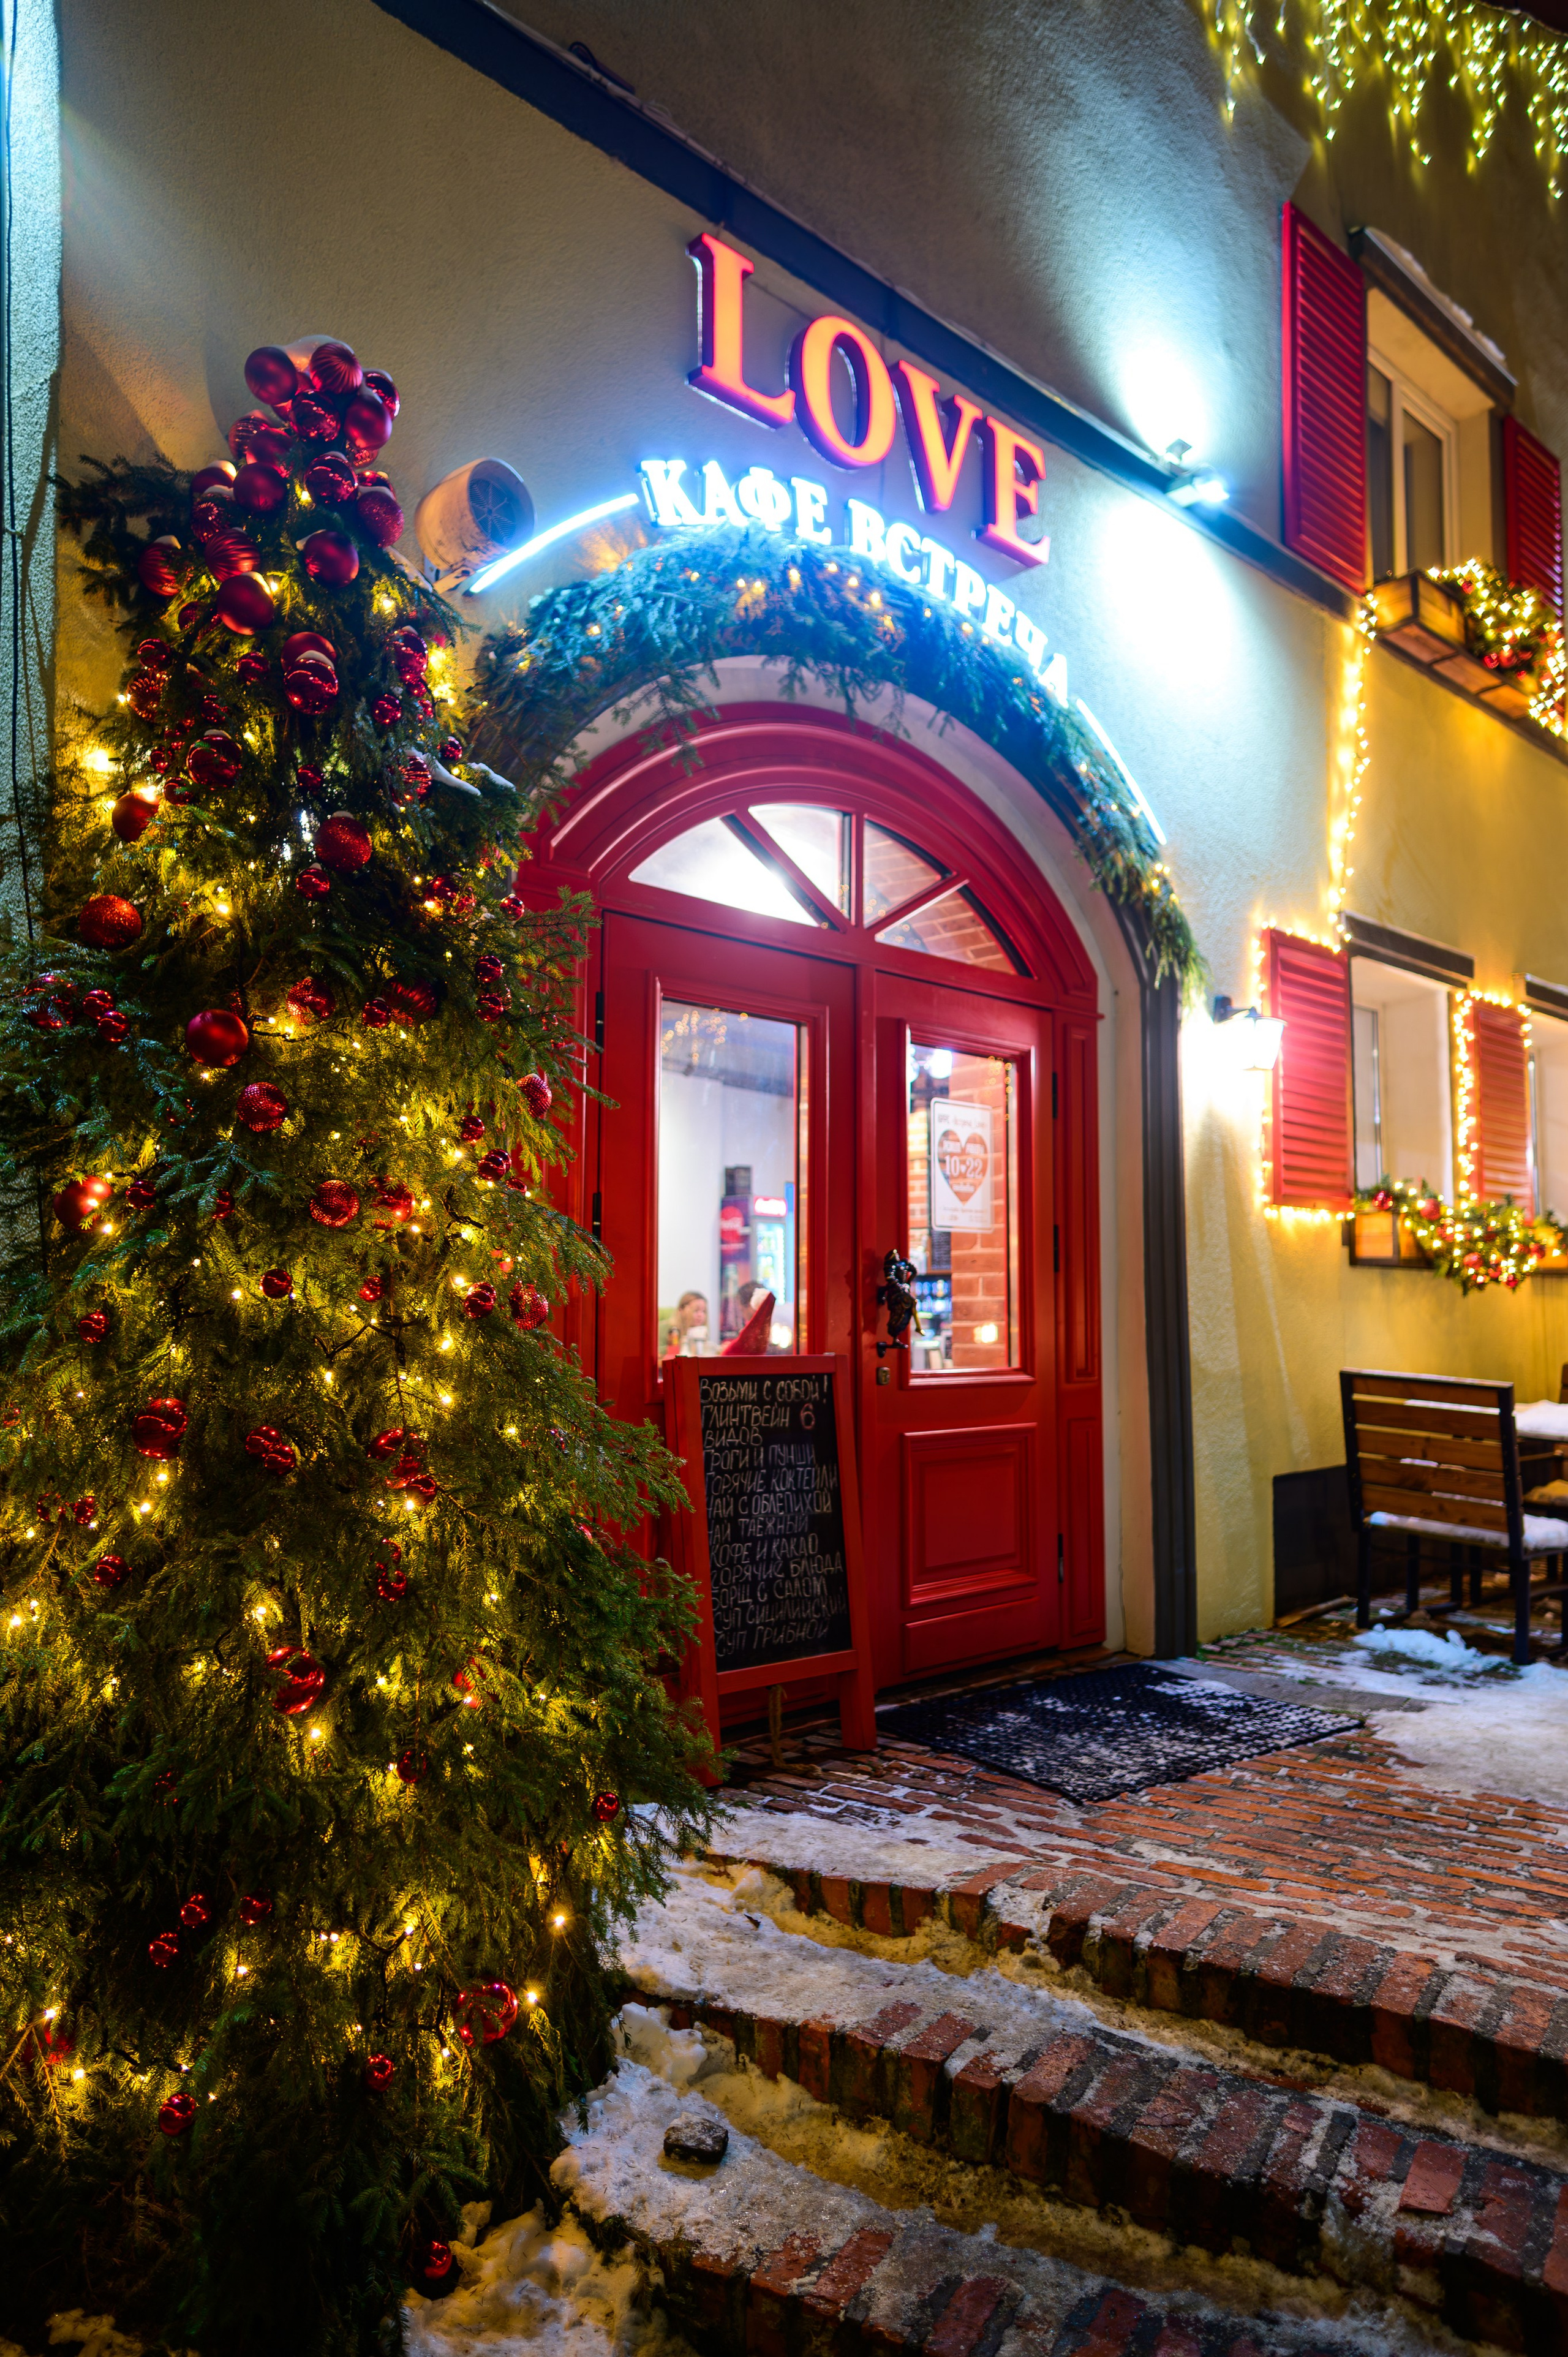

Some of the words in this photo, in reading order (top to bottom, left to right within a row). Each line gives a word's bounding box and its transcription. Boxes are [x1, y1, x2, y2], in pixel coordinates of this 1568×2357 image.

[686, 232, 1050, 570] LOVE
[641, 460, 832, 545] КАФЕ
[848, 499, 1069, 709] ВСТРЕЧА
[944, 1155, 960, 1177] 10
[965, 1157, 983, 1178] 22
[763, 1380, 771, 1400] С
[701, 1401, 790, 1428] ГЛИНТВЕЙН
[801, 1403, 815, 1430] 6
[704, 1427, 763, 1449] ВИДОВ
[703, 1447, 749, 1471] ГРОГИ
[754, 1446, 764, 1468] И
[769, 1443, 816, 1466] ПУНШИ
[706, 1469, 766, 1495] ГОРЯЧИЕ
[771, 1461, 839, 1492] КОКТЕЙЛИ
[706, 1494, 734, 1519] ЧАЙ
[738, 1496, 748, 1514] С
[752, 1488, 832, 1515] ОБЛЕПИХОЙ
[708, 1519, 731, 1545] ЧАЙ
[738, 1515, 809, 1539] ТАЕЖНЫЙ
[710, 1542, 752, 1568] КОФЕ
[756, 1539, 768, 1561] И
[771, 1533, 818, 1560] КАКАО
[790, 1551, 844, 1577] БЛЮДА
[757, 1582, 767, 1602] С
[773, 1575, 828, 1599] САЛОМ
[713, 1608, 742, 1634] СУП
[715, 1630, 747, 1656] СУП
[753, 1618, 830, 1649] ГРИБНОЙ
